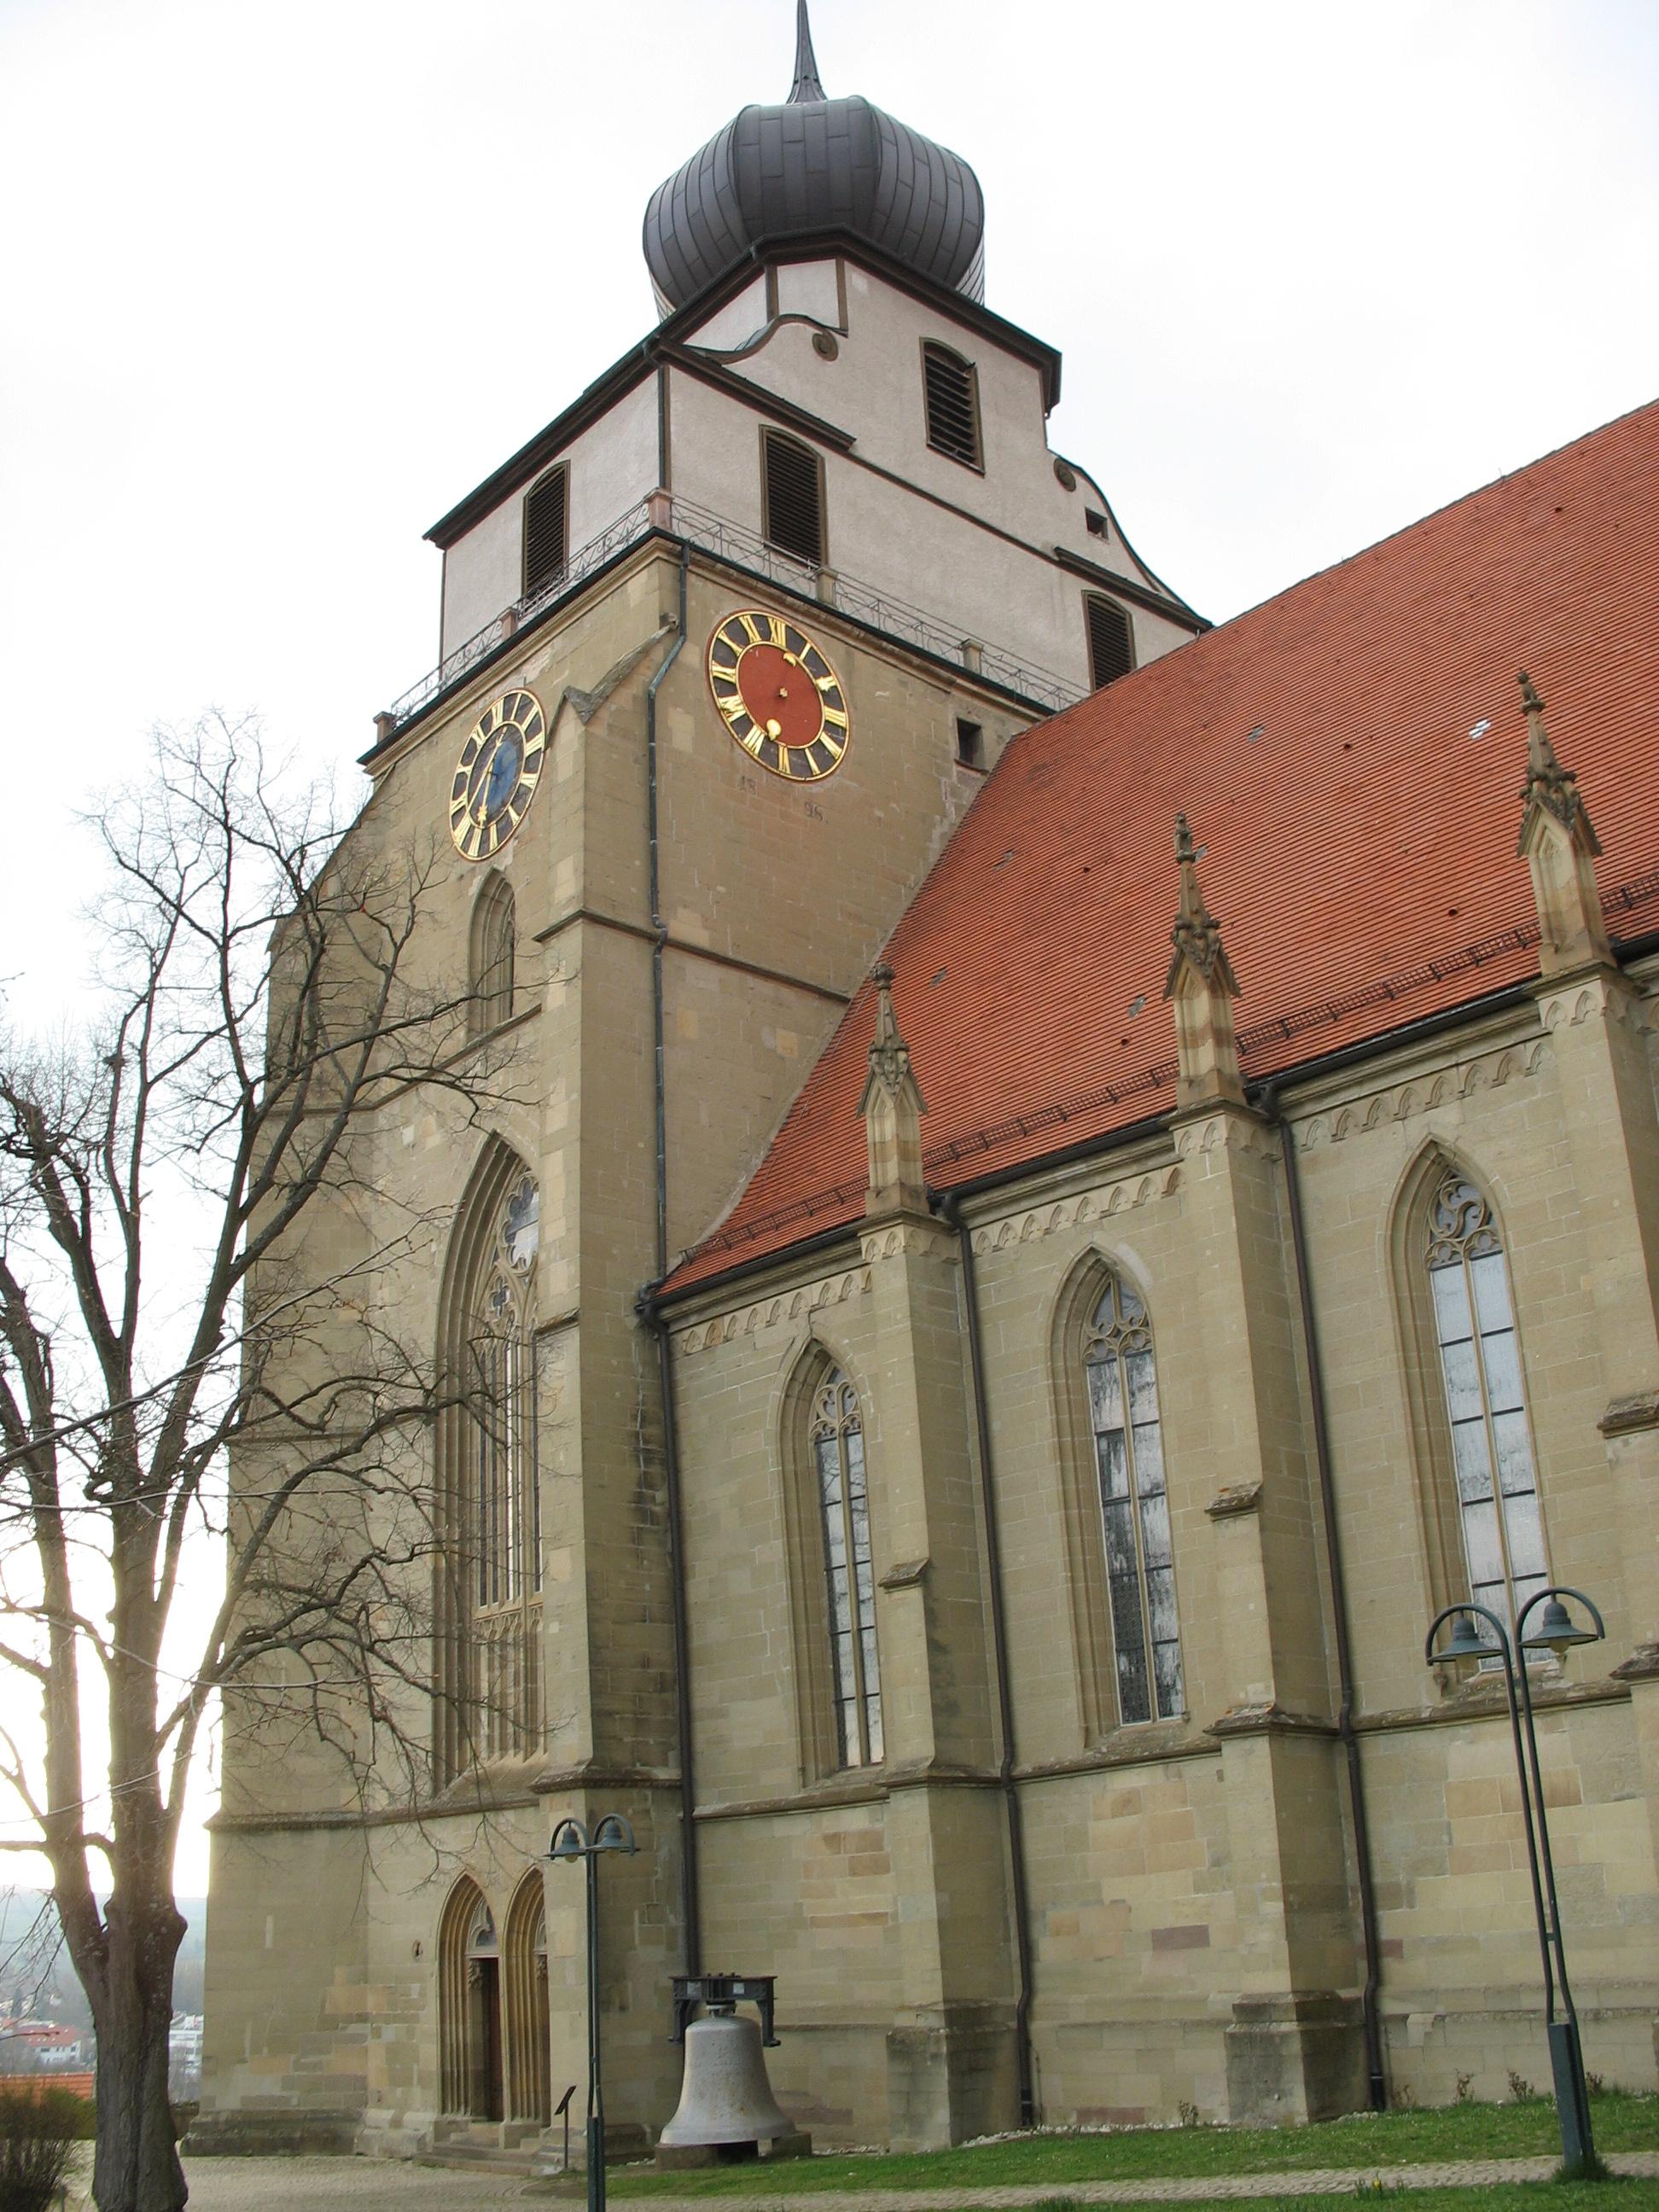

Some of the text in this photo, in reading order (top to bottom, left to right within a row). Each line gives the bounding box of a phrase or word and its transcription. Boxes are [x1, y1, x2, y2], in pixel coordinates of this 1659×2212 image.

[739, 614, 761, 642] XI
[768, 616, 787, 649] XII
[719, 630, 744, 657] X
[799, 642, 812, 661] I
[712, 660, 736, 684] IX
[824, 706, 847, 728] III
[743, 725, 765, 757] VII
[778, 744, 791, 774] VI
[806, 748, 820, 776] V
